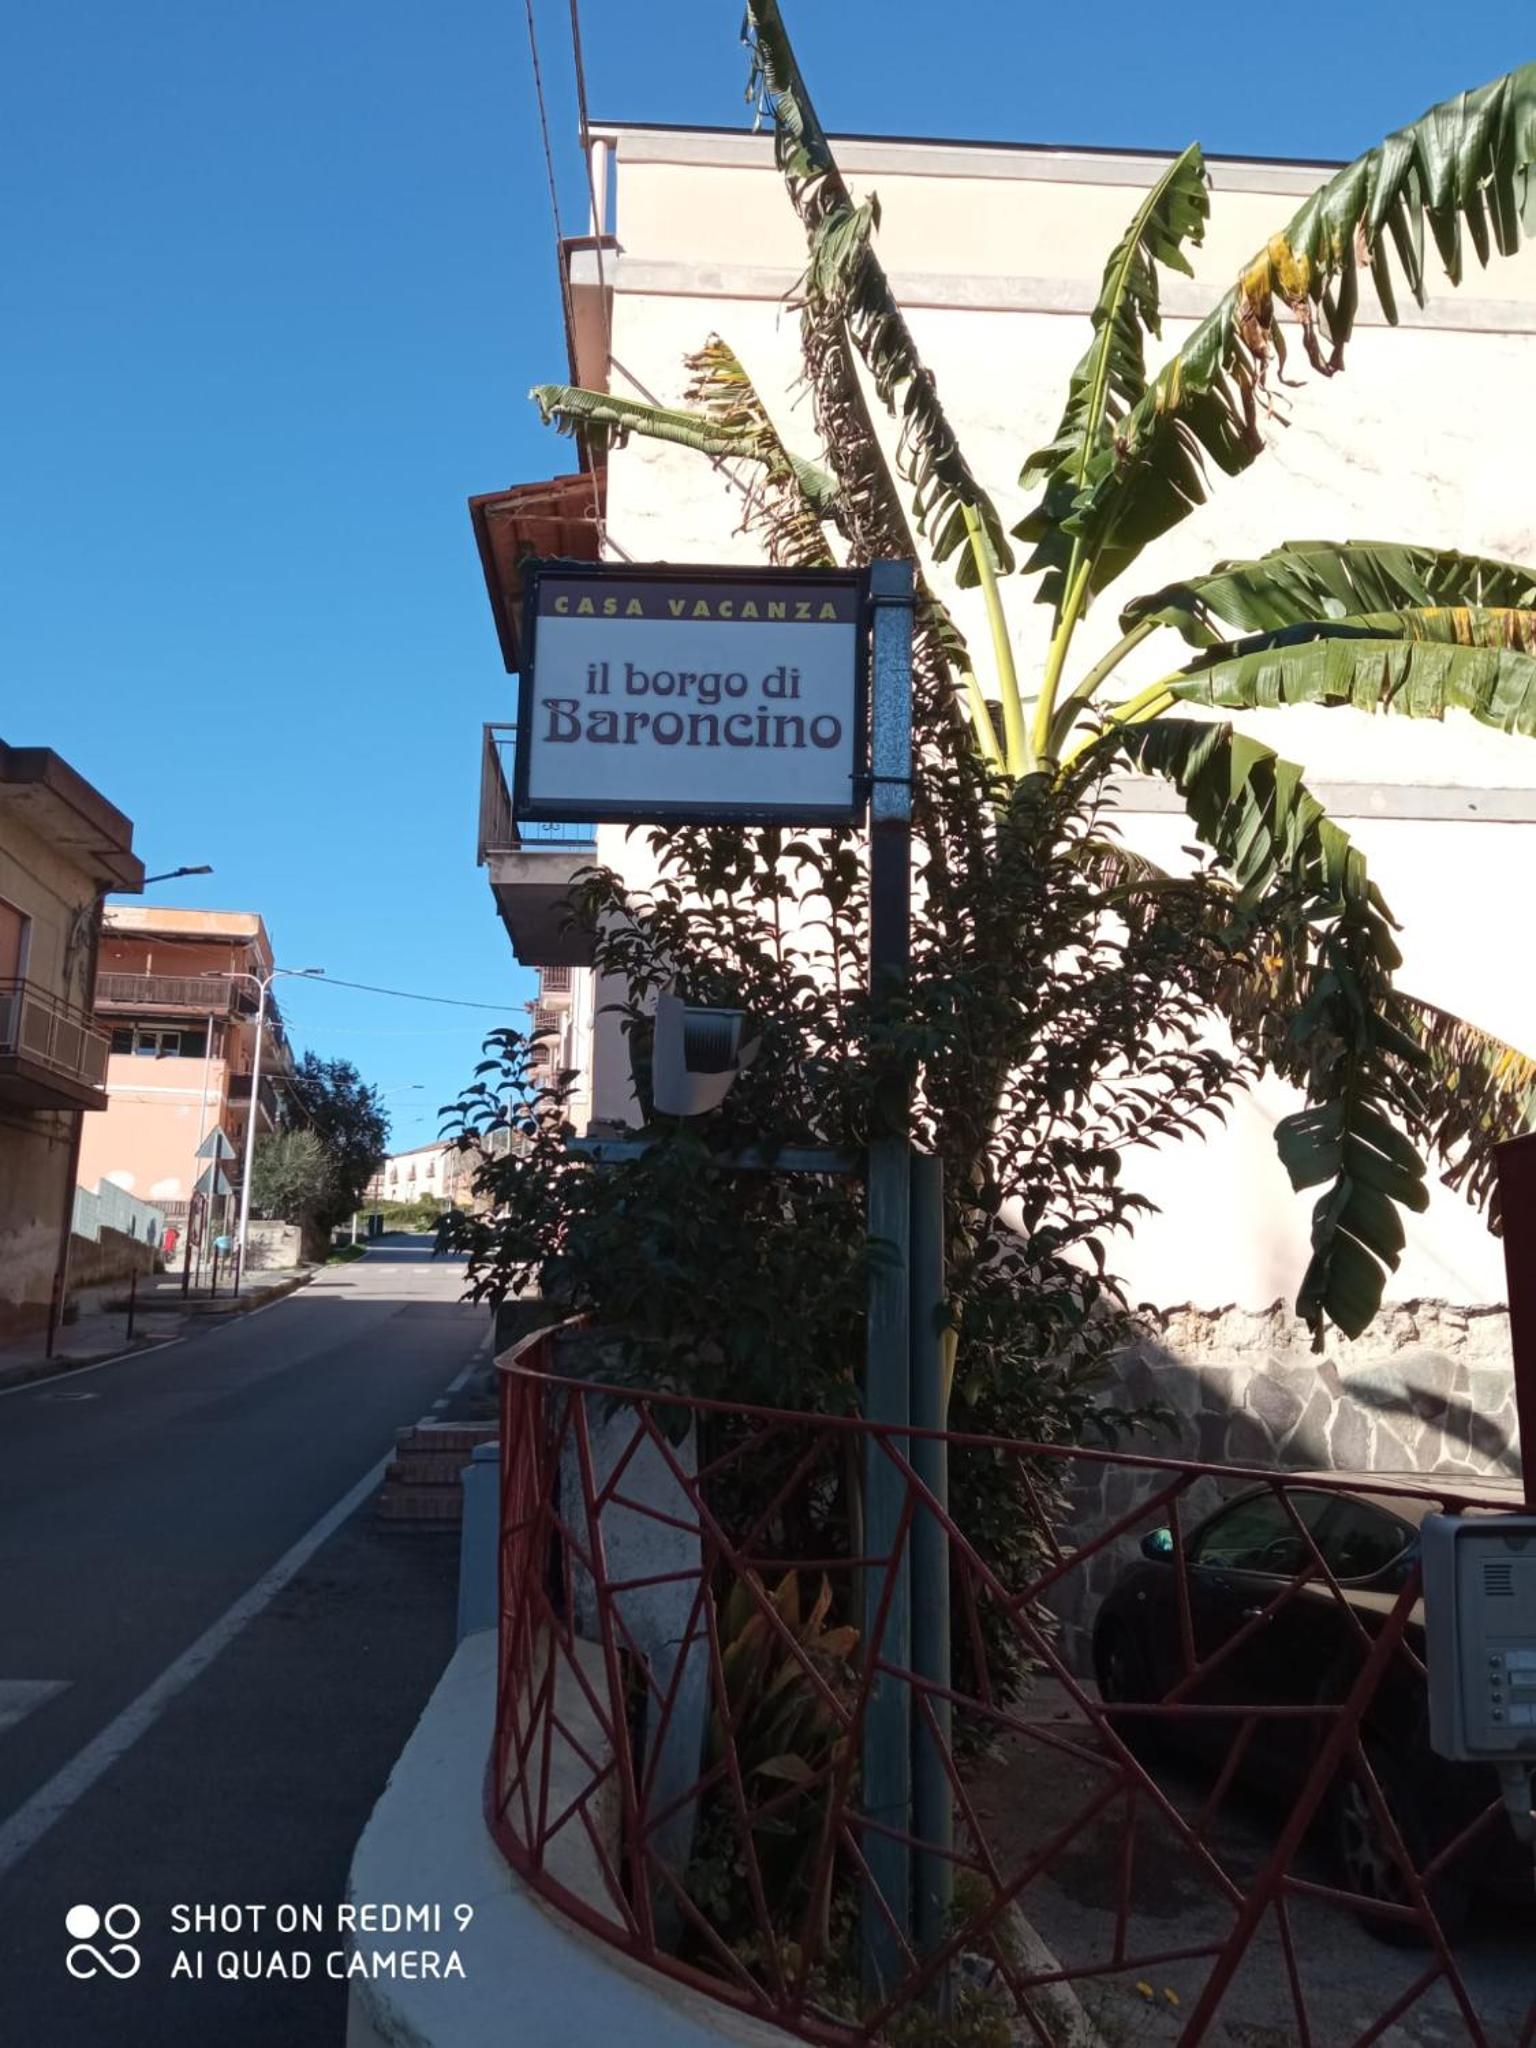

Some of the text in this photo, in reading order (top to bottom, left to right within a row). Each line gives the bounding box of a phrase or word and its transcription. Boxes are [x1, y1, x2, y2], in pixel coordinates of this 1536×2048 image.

[554, 596, 838, 620] CASA VACANZA
[585, 662, 801, 705] il borgo di
[541, 698, 843, 749] Baroncino
